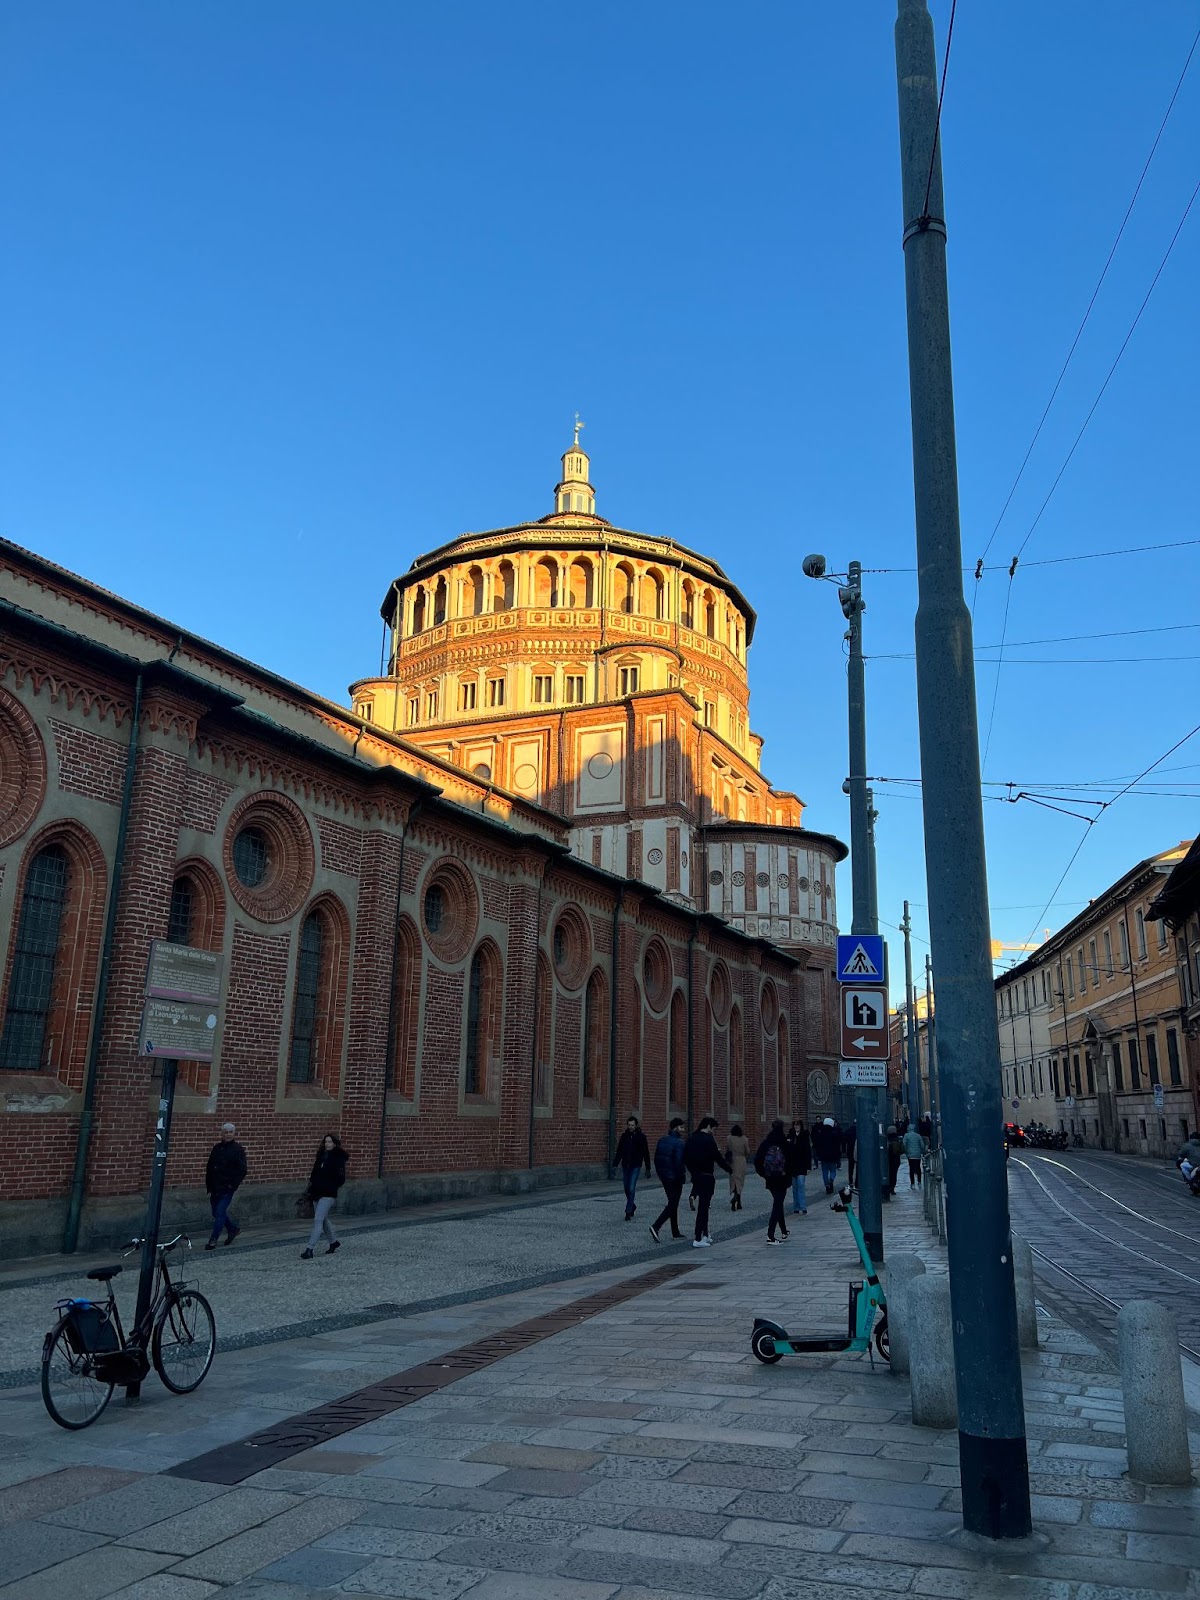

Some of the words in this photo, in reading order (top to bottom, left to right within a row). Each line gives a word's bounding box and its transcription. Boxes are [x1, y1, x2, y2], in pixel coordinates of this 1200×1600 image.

[155, 944, 172, 953] Santa
[172, 947, 188, 957] Maria
[188, 951, 201, 959] delle
[201, 953, 216, 963] Grazie
[154, 1010, 180, 1020] Leonardo
[188, 1014, 201, 1022] Vinci
[244, 1384, 439, 1448] SANTA
[427, 1330, 554, 1368] MARIA
